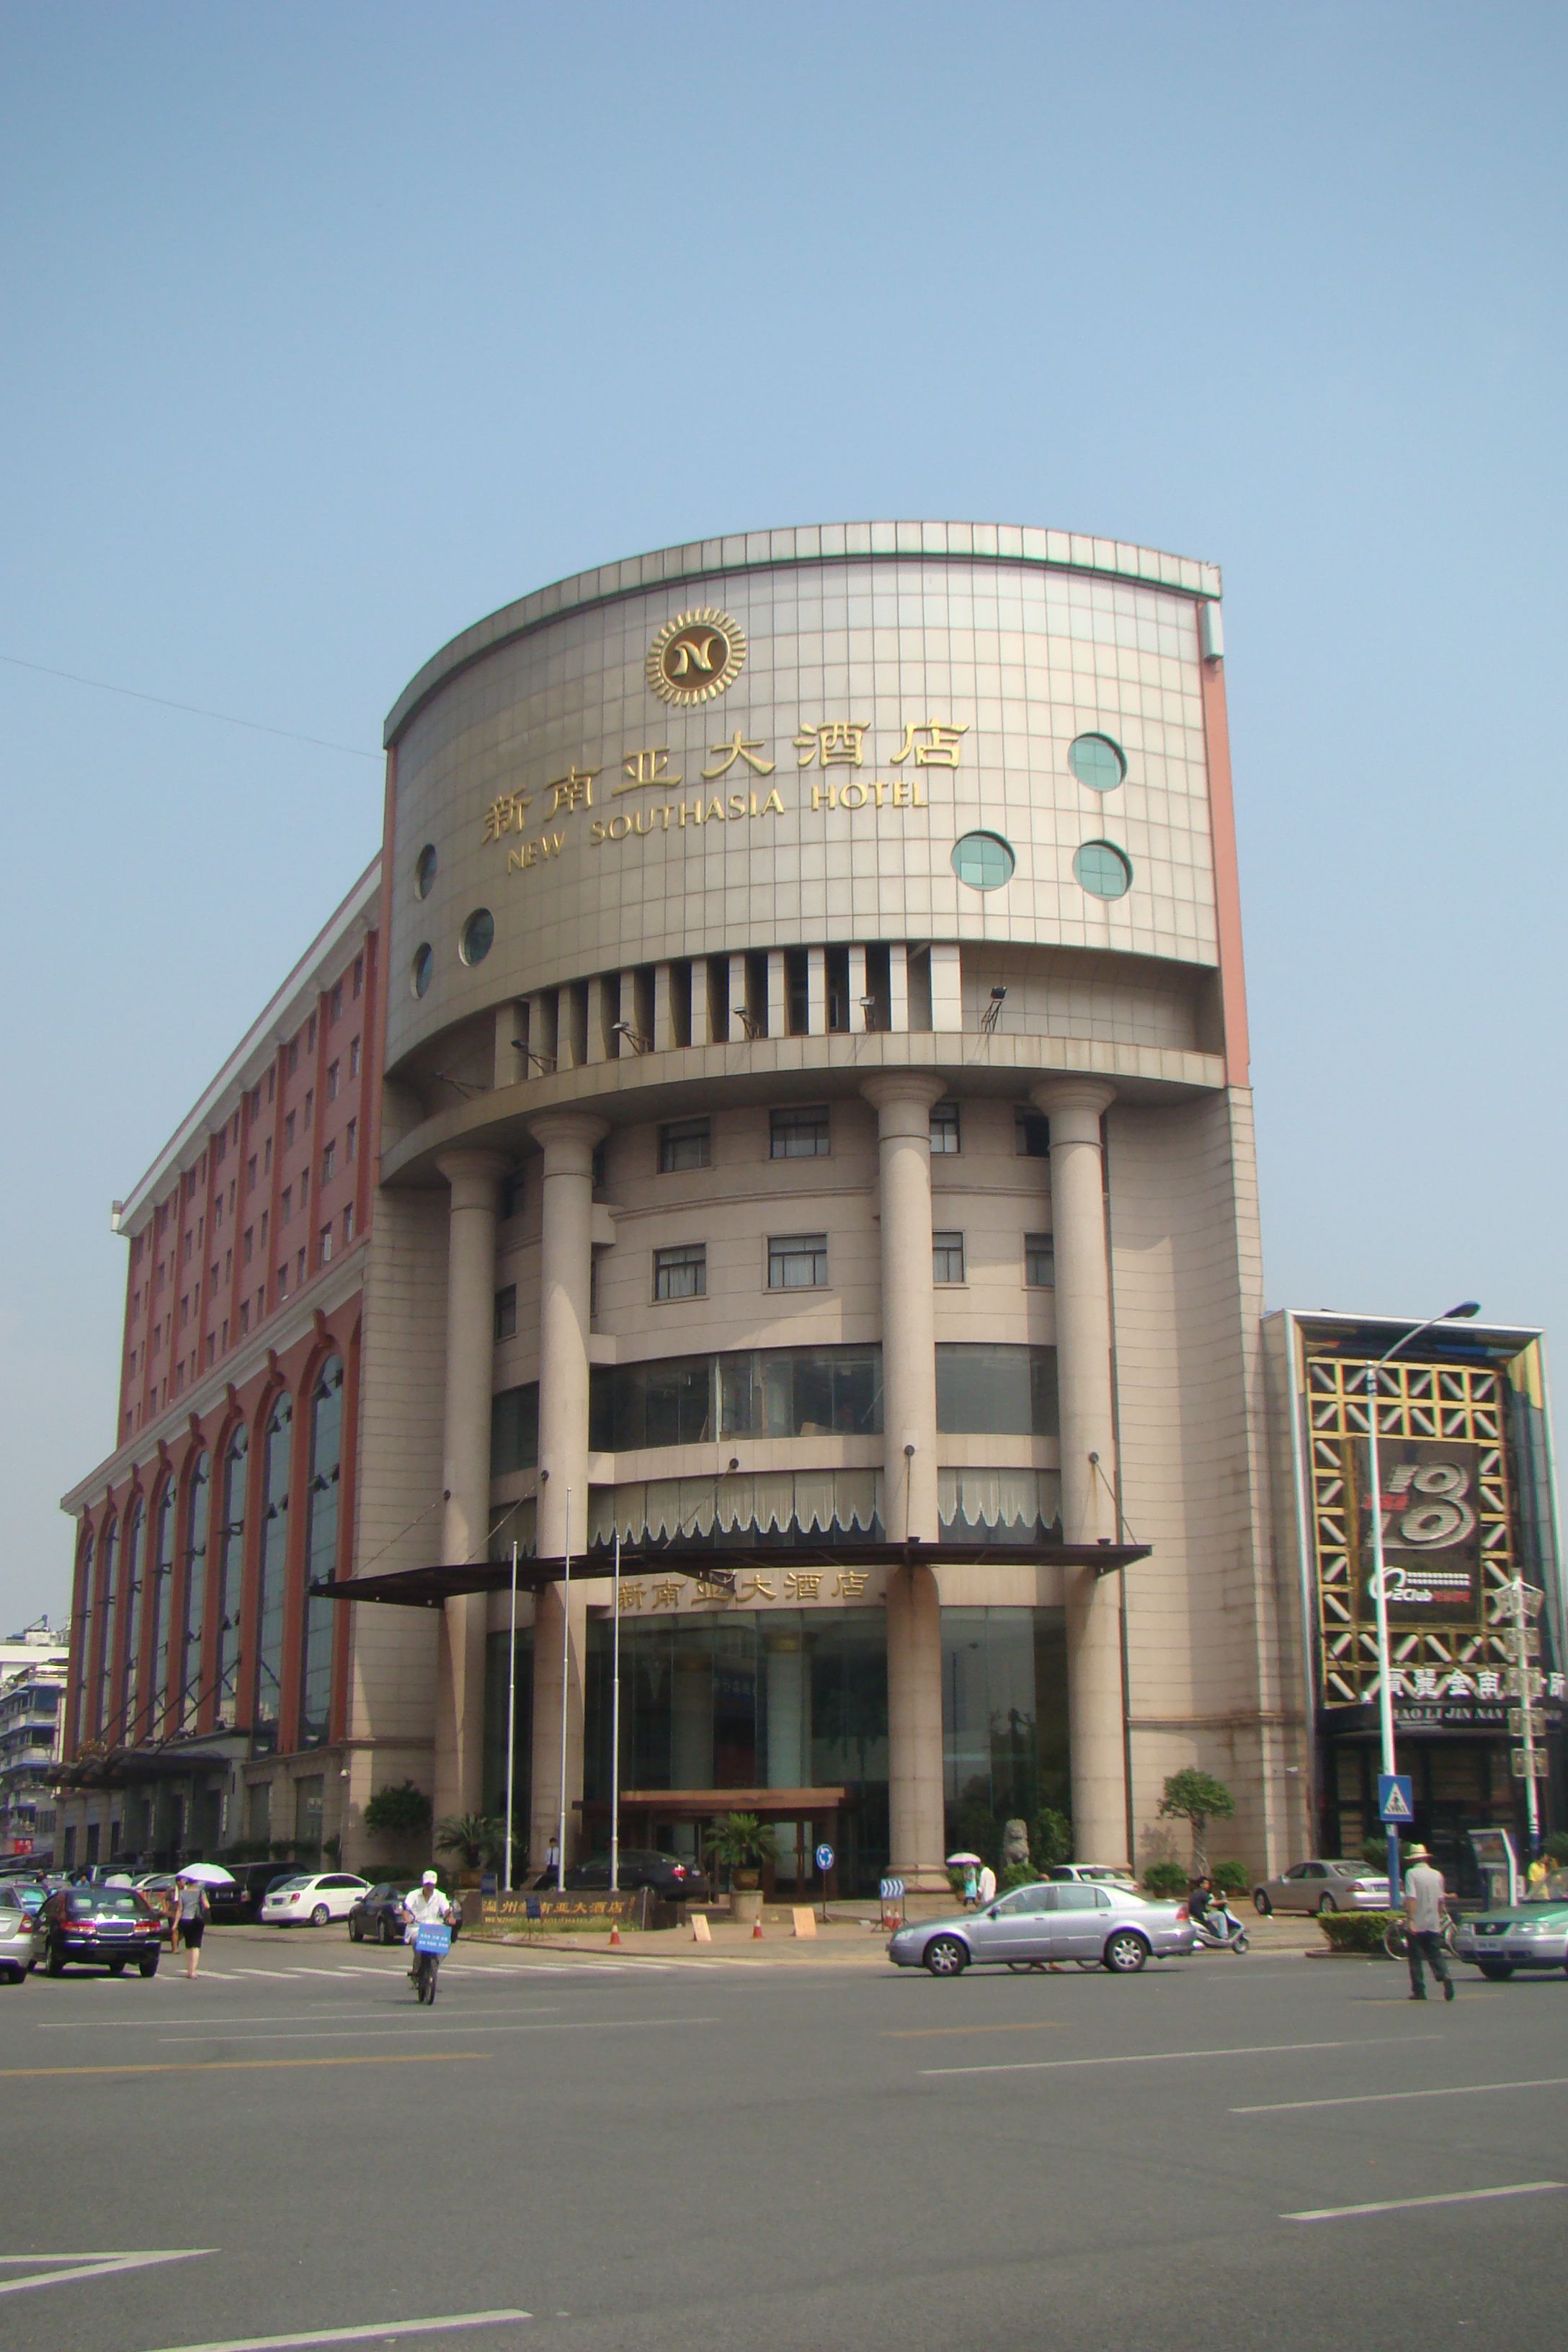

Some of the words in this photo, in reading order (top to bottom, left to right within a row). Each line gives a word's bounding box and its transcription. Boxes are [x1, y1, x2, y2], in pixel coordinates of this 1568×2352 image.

[481, 717, 971, 846] 新南亚大酒店
[507, 830, 566, 876] NEW
[589, 788, 784, 846] SOUTHASIA
[811, 779, 928, 810] HOTEL
